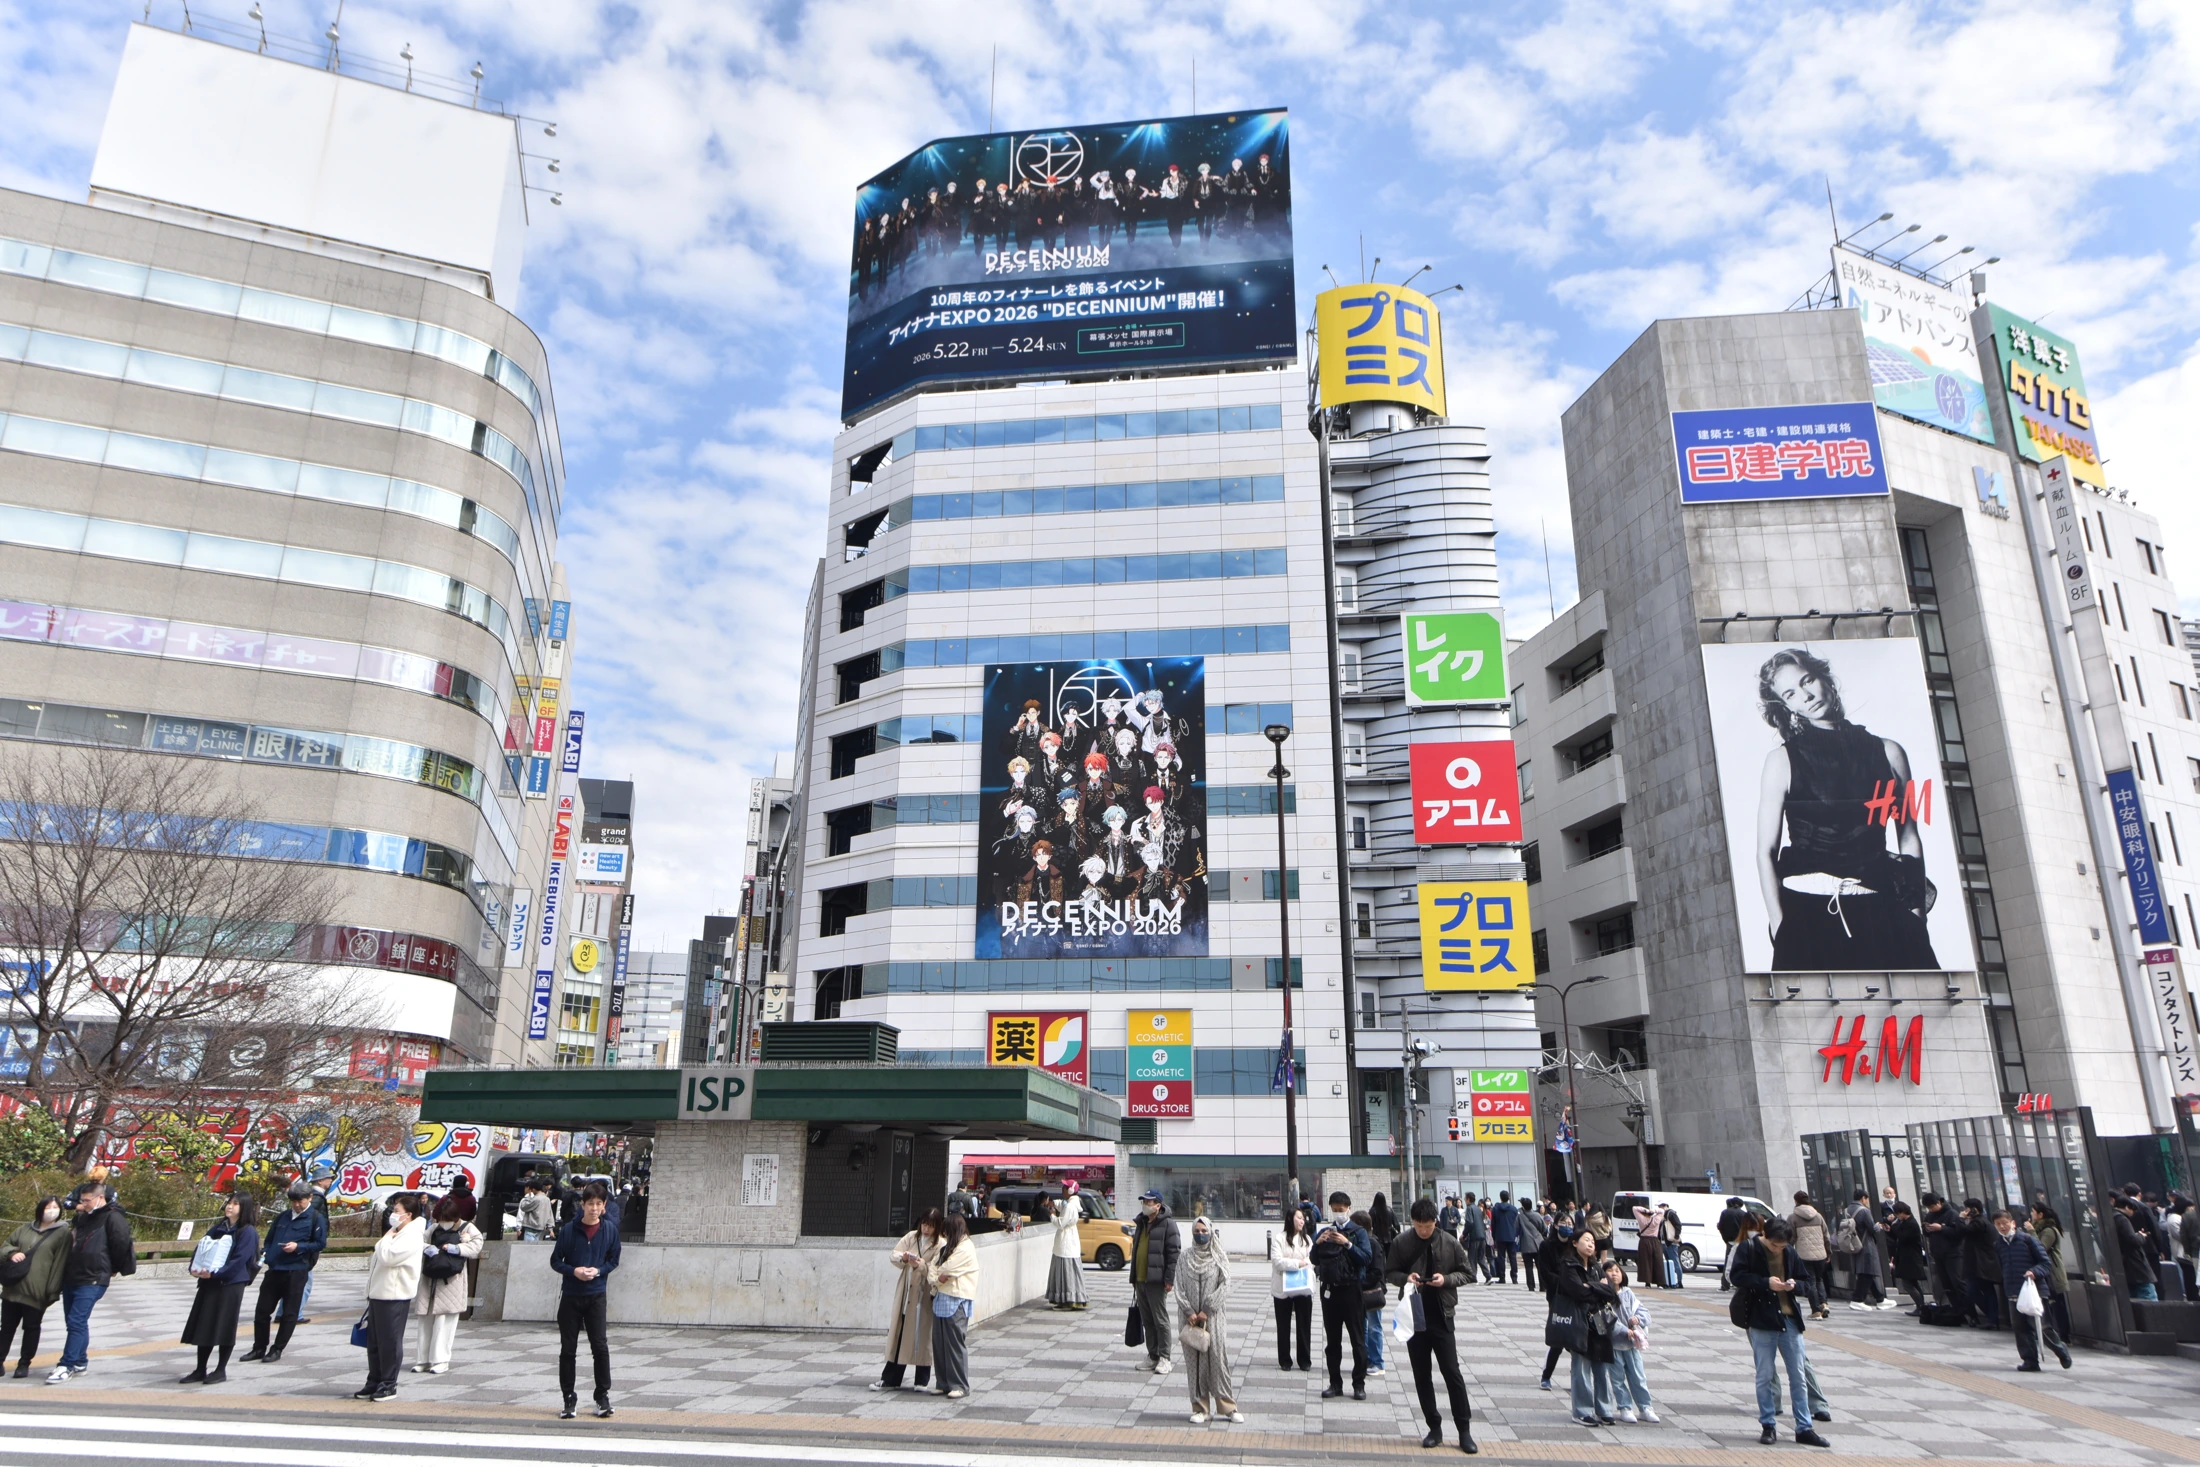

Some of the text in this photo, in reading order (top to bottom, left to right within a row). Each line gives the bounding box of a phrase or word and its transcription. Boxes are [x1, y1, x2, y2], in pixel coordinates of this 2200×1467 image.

[985, 243, 1110, 269] DECENNIUM
[1033, 258, 1073, 272] EXPO
[1076, 255, 1110, 268] 2026
[931, 277, 1166, 306] 10周年のフィナーレを飾るイベント
[1841, 261, 1967, 322] 自然エネルギーの
[995, 303, 1037, 321] 2026
[1341, 290, 1430, 347] プロ
[1874, 302, 1974, 358] アドバンス
[912, 336, 1067, 364] 2026 5.22 FRI 5.24 SUN
[2010, 324, 2070, 373] 洋菓子
[1345, 345, 1434, 396] ミス
[2009, 359, 2090, 430] タカセ
[2023, 415, 2096, 465] TAKASE
[1686, 438, 1875, 483] 日建学院
[2051, 487, 2078, 562] 献血ルーム
[2071, 585, 2088, 600] 8F
[552, 603, 566, 637] 大同生命
[0, 607, 336, 665] レディースアートネイチャー
[1415, 650, 1484, 682] イク
[539, 707, 555, 716] 6F
[158, 722, 199, 735] 土日祝
[164, 734, 189, 746] 診療
[211, 728, 237, 740] EYE
[201, 739, 243, 752] CLINIC
[253, 730, 330, 764] 眼科
[564, 729, 582, 770] LABI
[1422, 798, 1511, 827] アコム
[1864, 778, 1932, 827] H&M
[552, 811, 573, 861] LABI
[600, 836, 625, 844] scape
[601, 827, 626, 836] grand
[2115, 788, 2158, 926] 中安眼科クリニック
[542, 862, 560, 946] IKEBUKURO
[1002, 900, 1182, 926] DECENNIUM
[1434, 891, 1514, 932] プロ
[510, 903, 527, 951] ソフマップ
[1002, 919, 1182, 937] アイナナ EXPO 2026
[1439, 937, 1518, 974] ミス
[2151, 952, 2171, 964] 4F
[530, 992, 549, 1037] LABI
[613, 991, 623, 1012] TBC
[1154, 1018, 1165, 1026] 3F
[2157, 970, 2195, 1083] コンタクトレンズ
[364, 1038, 431, 1059] TAX FREE
[995, 1021, 1035, 1061] 薬
[1136, 1033, 1184, 1042] COSMETIC
[1817, 1014, 1923, 1086] H&M
[1154, 1053, 1166, 1061] 2F
[1136, 1068, 1184, 1077] COSMETIC
[1456, 1073, 1518, 1087] 3F レイク
[686, 1076, 745, 1113] ISP
[1155, 1088, 1166, 1097] 1F
[1457, 1100, 1525, 1111] 2F アコム
[1132, 1104, 1190, 1113] DRUG STORE
[1479, 1122, 1529, 1135] プロミス
